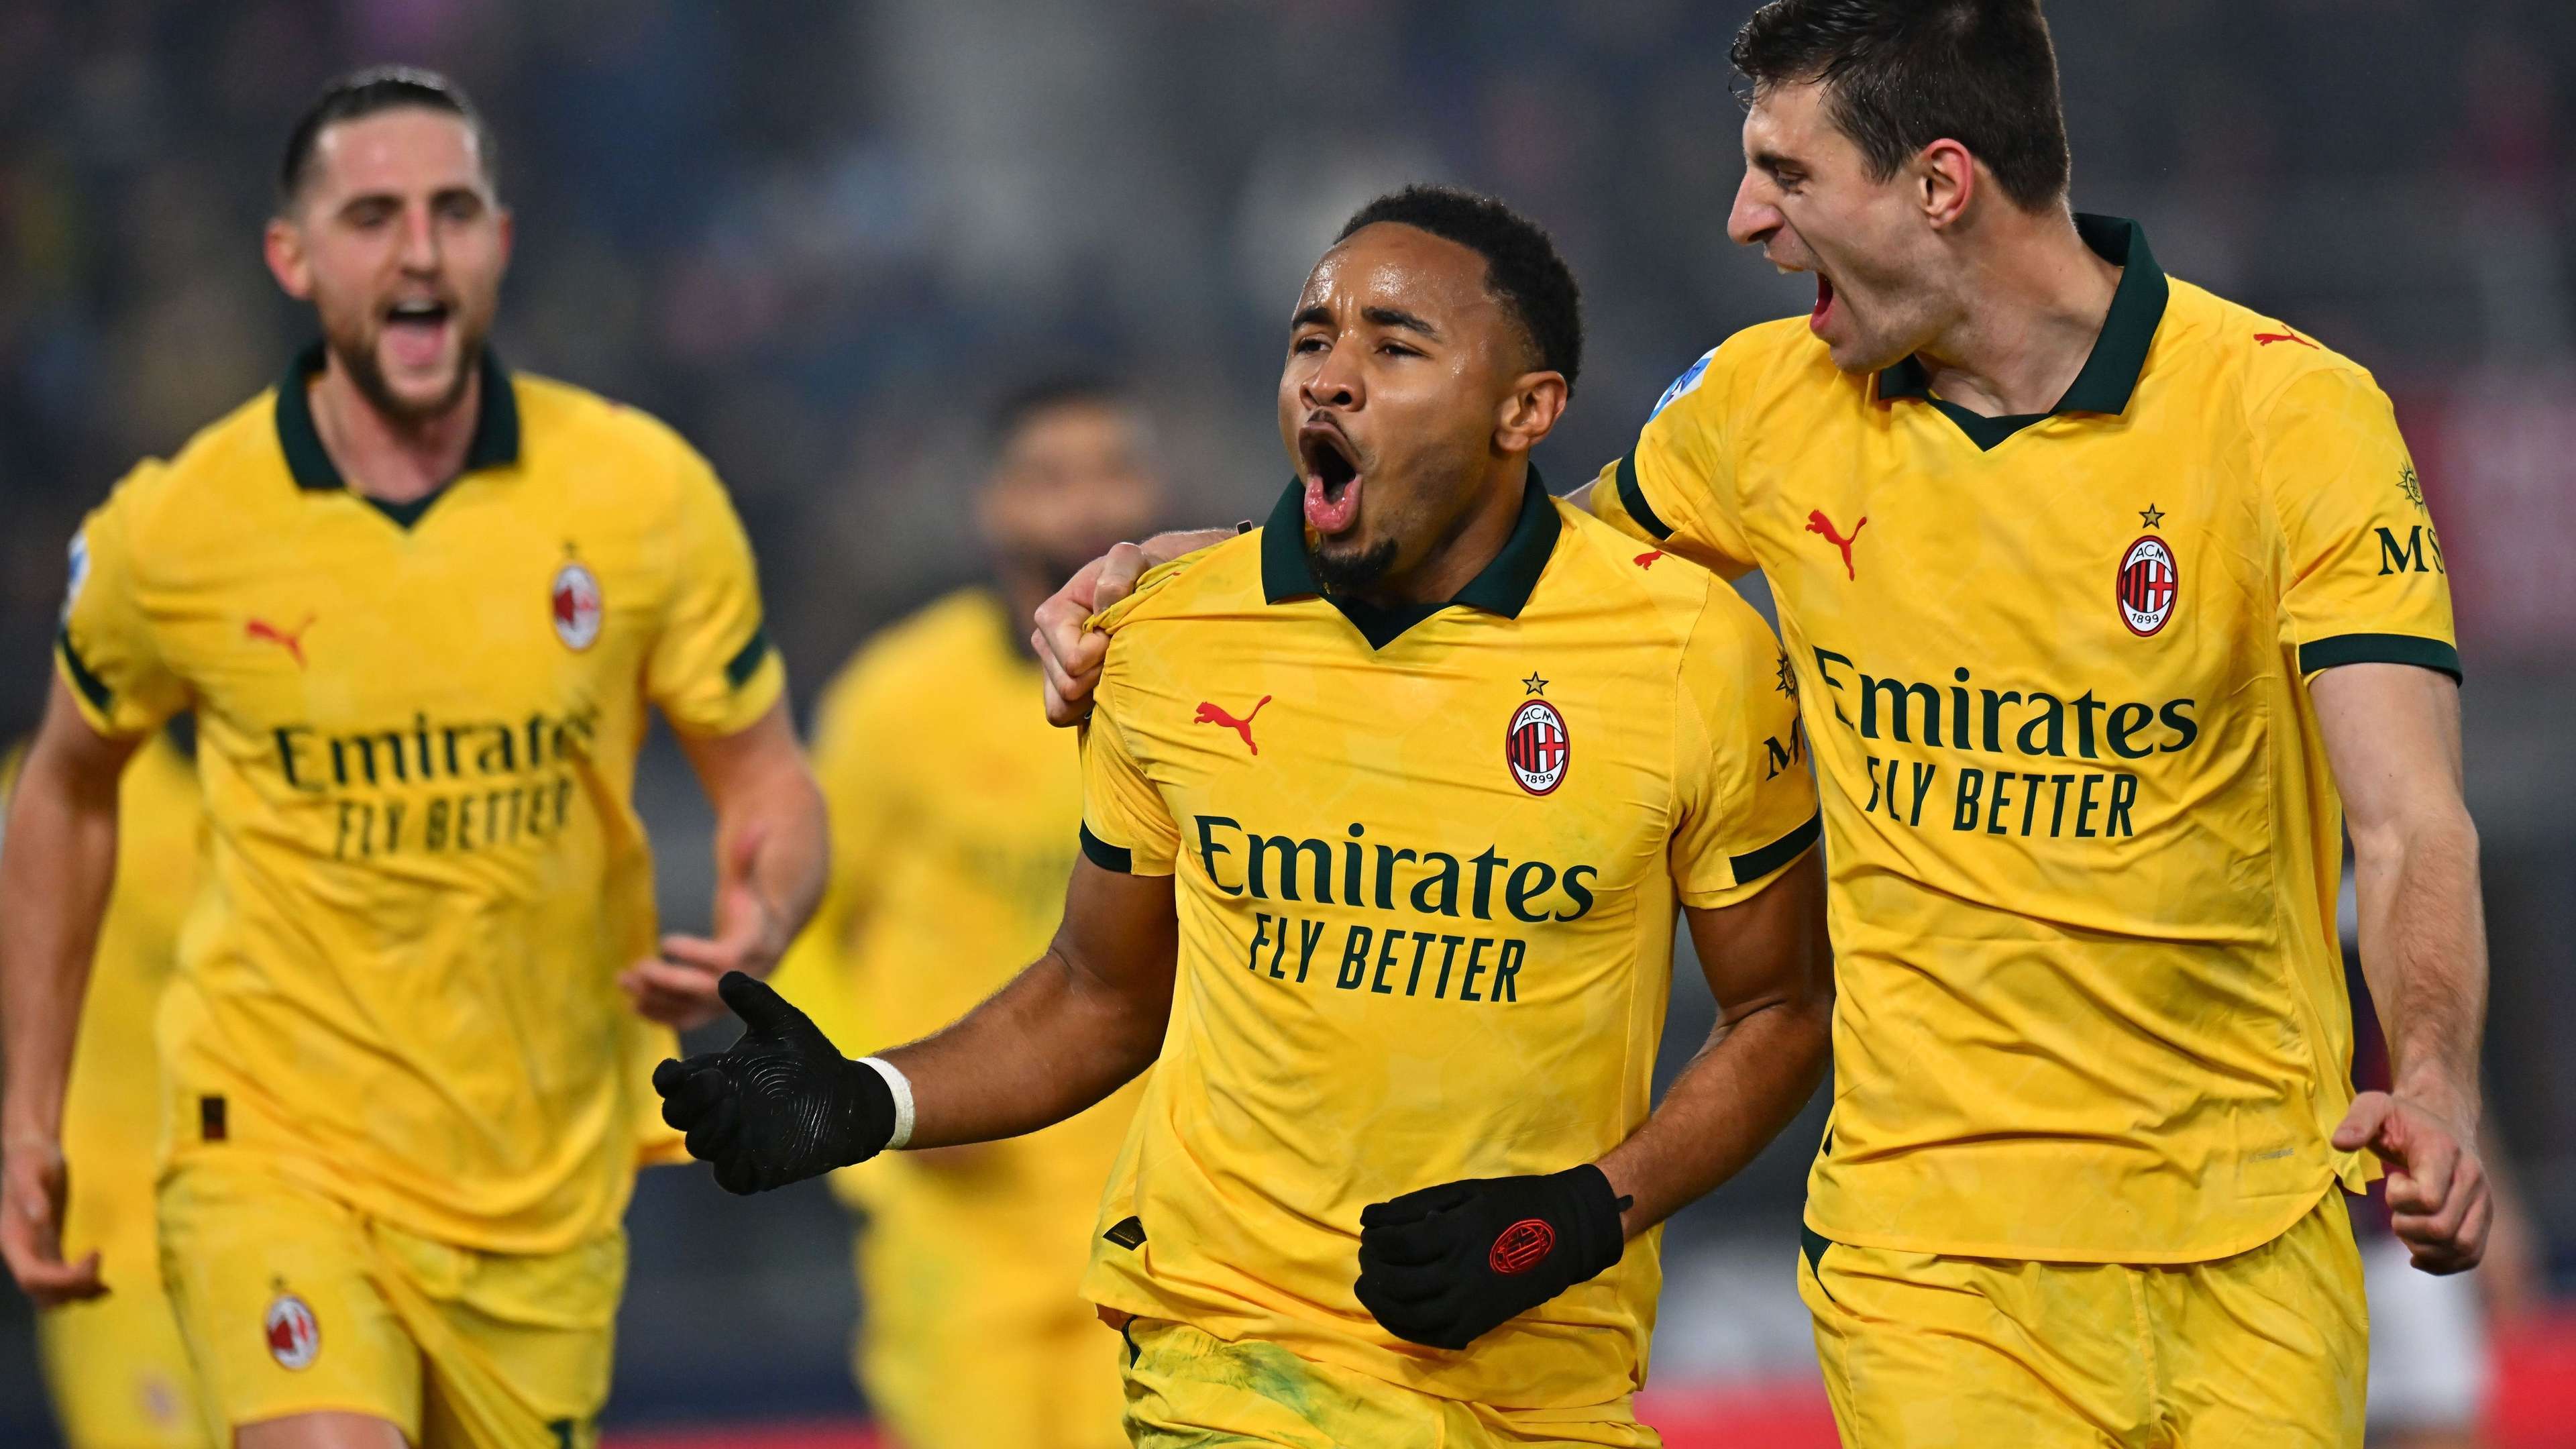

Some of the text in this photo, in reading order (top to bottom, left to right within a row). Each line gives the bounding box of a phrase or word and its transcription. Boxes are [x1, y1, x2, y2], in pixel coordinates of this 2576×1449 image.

[2132, 544, 2166, 563] ACM
[2131, 612, 2159, 624] 1899
[1519, 708, 1554, 726] ACM
[1811, 644, 2198, 759] Emirates
[1524, 773, 1554, 784] 1899
[1864, 755, 2139, 838] FLY BETTER
[334, 800, 408, 860] FLY
[1193, 814, 1598, 924] Emirates
[1248, 912, 1527, 1003] FLY BETTER
